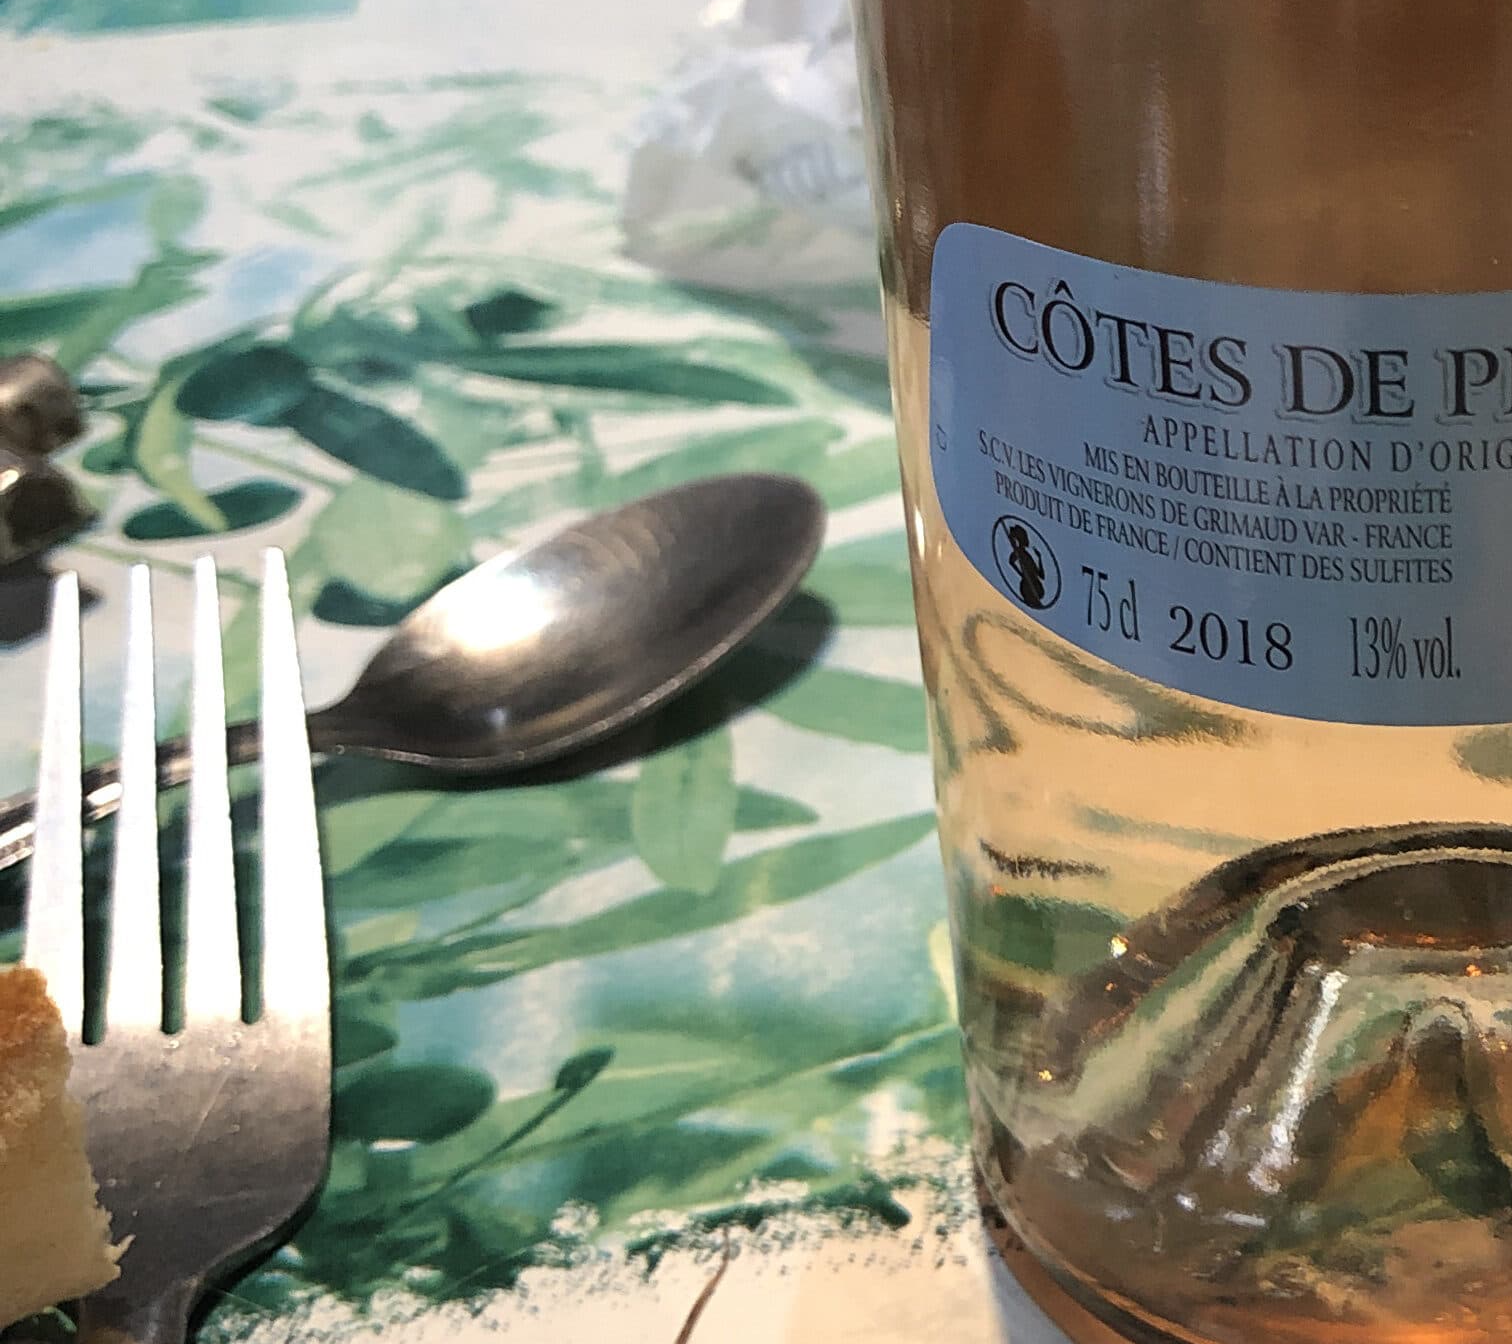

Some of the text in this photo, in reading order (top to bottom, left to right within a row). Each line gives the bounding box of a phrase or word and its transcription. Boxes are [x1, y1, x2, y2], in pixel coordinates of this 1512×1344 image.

[995, 280, 1251, 407] CÔTES
[1284, 344, 1414, 417] DE
[1084, 441, 1453, 514] MIS EN BOUTEILLE À LA PROPRIÉTÉ
[1143, 414, 1371, 473] APPELLATION
[995, 470, 1063, 525] PRODUIT
[1068, 505, 1093, 536] DE
[1098, 513, 1169, 556] FRANCE
[1184, 537, 1296, 578] CONTIENT
[1303, 555, 1344, 581] DES
[1351, 558, 1454, 584] SULFITES
[1018, 450, 1046, 484] LES
[1048, 463, 1156, 522] VIGNERONS
[1161, 498, 1189, 527] DE
[1194, 505, 1298, 544] GRIMAUD
[1303, 520, 1348, 549] VAR
[1366, 523, 1453, 550] FRANCE
[1082, 566, 1462, 680] 75 cl 2018 13% vol.
